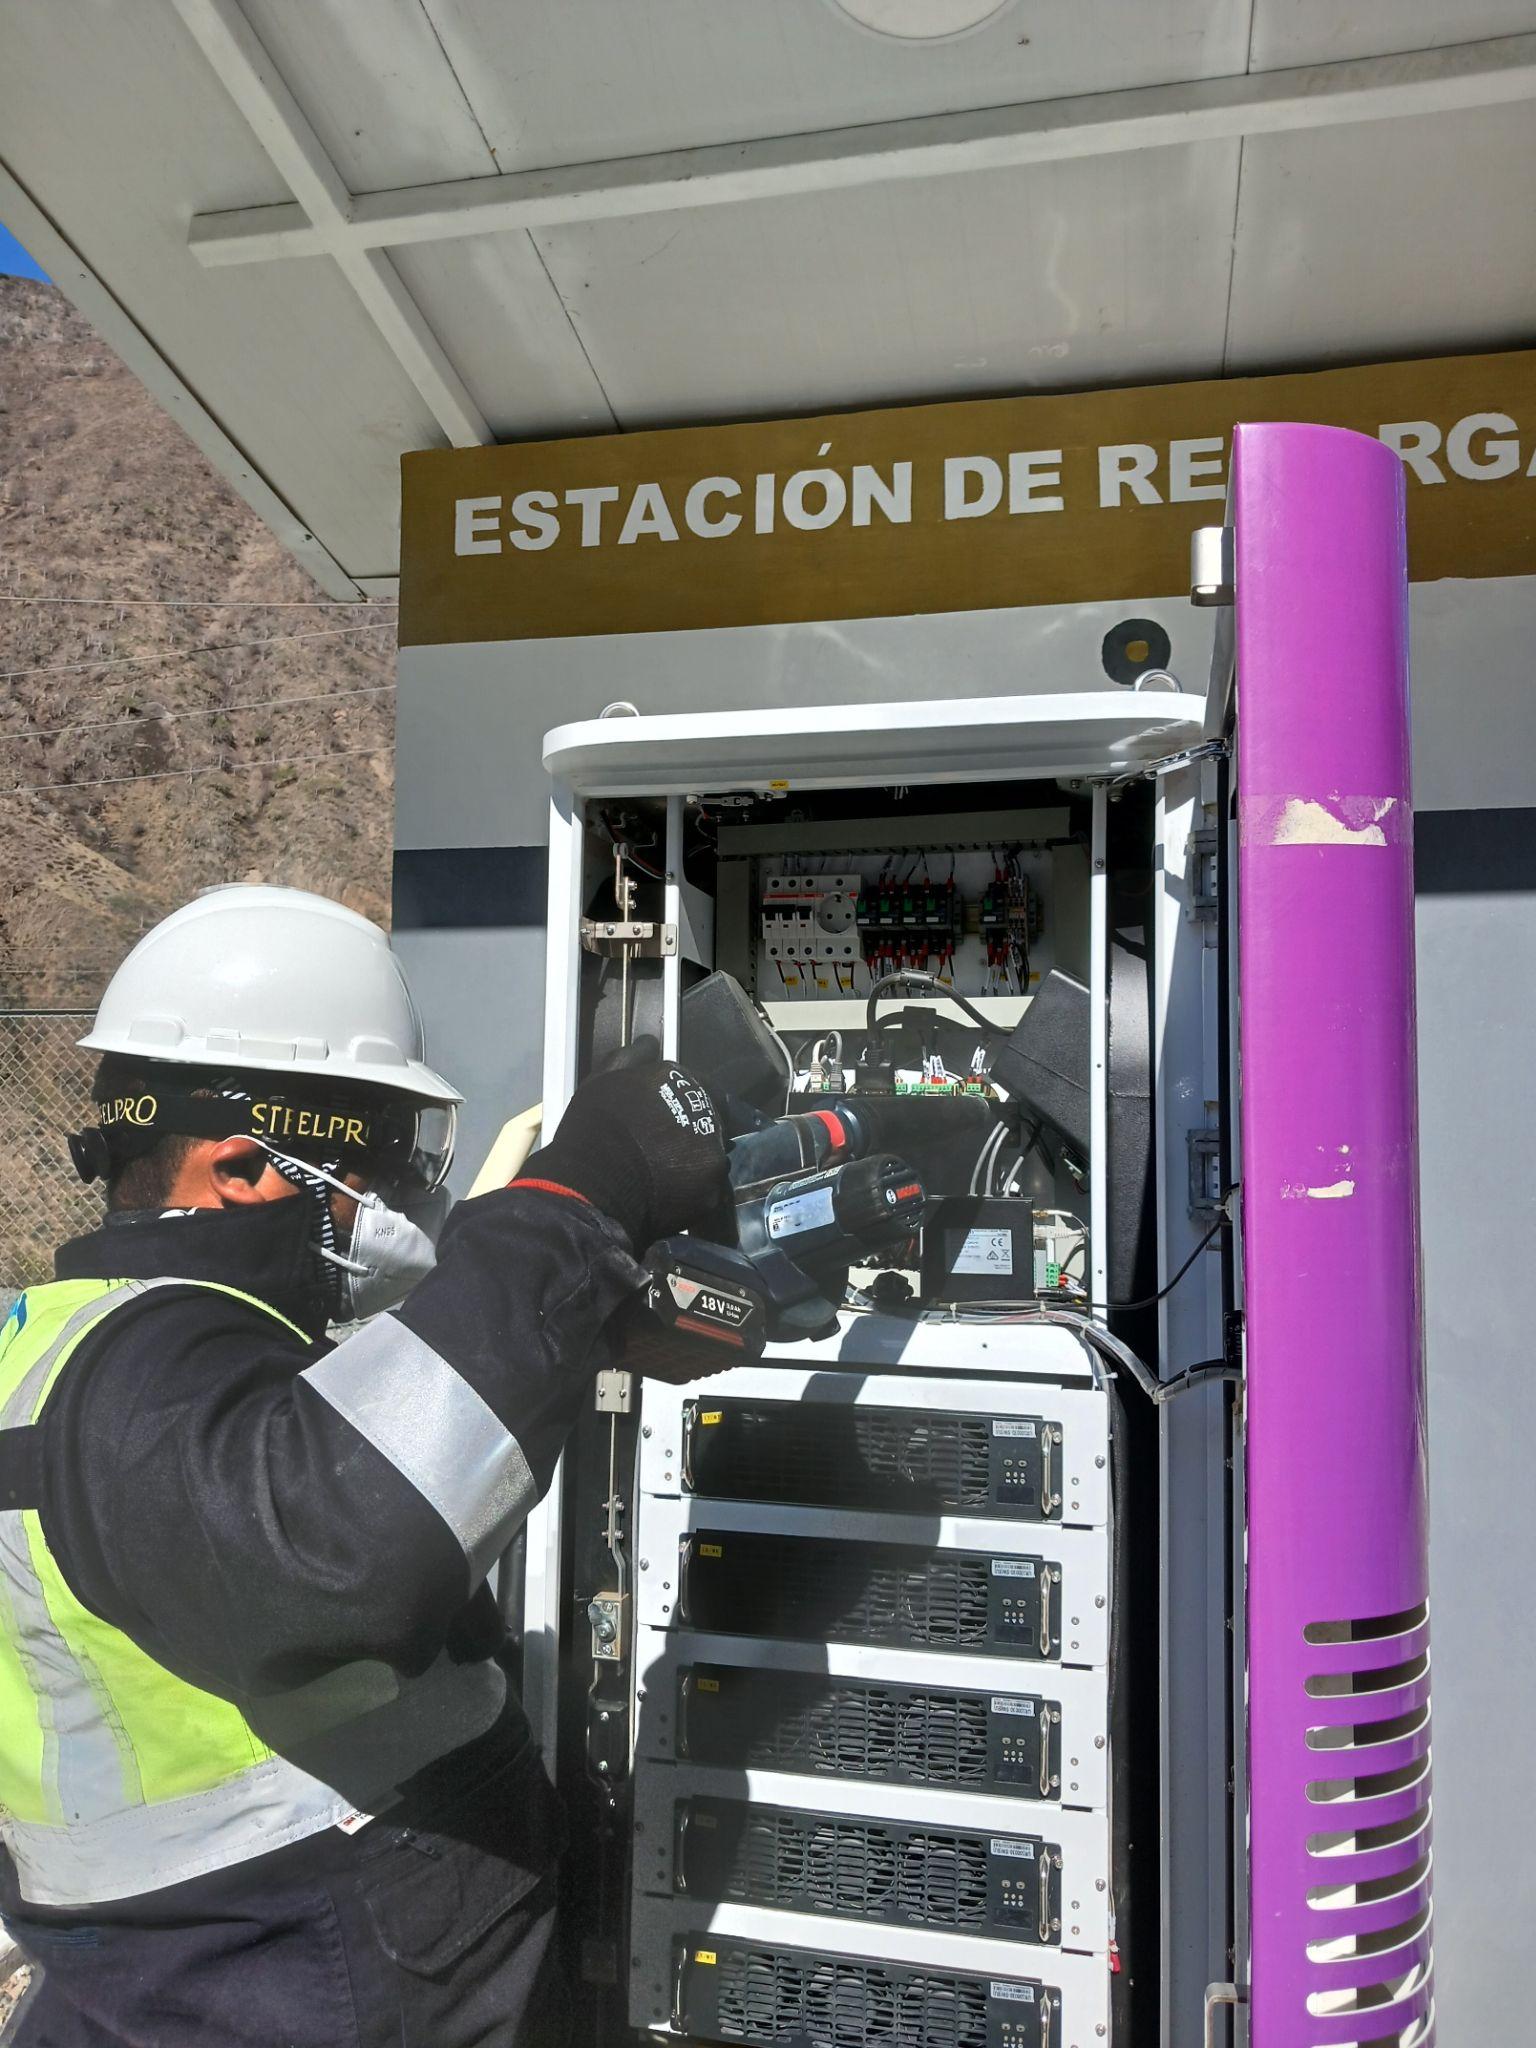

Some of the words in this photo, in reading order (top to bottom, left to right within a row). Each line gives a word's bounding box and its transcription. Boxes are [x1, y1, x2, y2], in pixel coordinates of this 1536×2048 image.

[455, 442, 913, 557] ESTACIÓN
[944, 449, 1064, 520] DE
[1098, 412, 1536, 508] RERG
[100, 1094, 157, 1126] ELPRO
[251, 1103, 369, 1146] STEELPR
[701, 1295, 725, 1314] 18V
